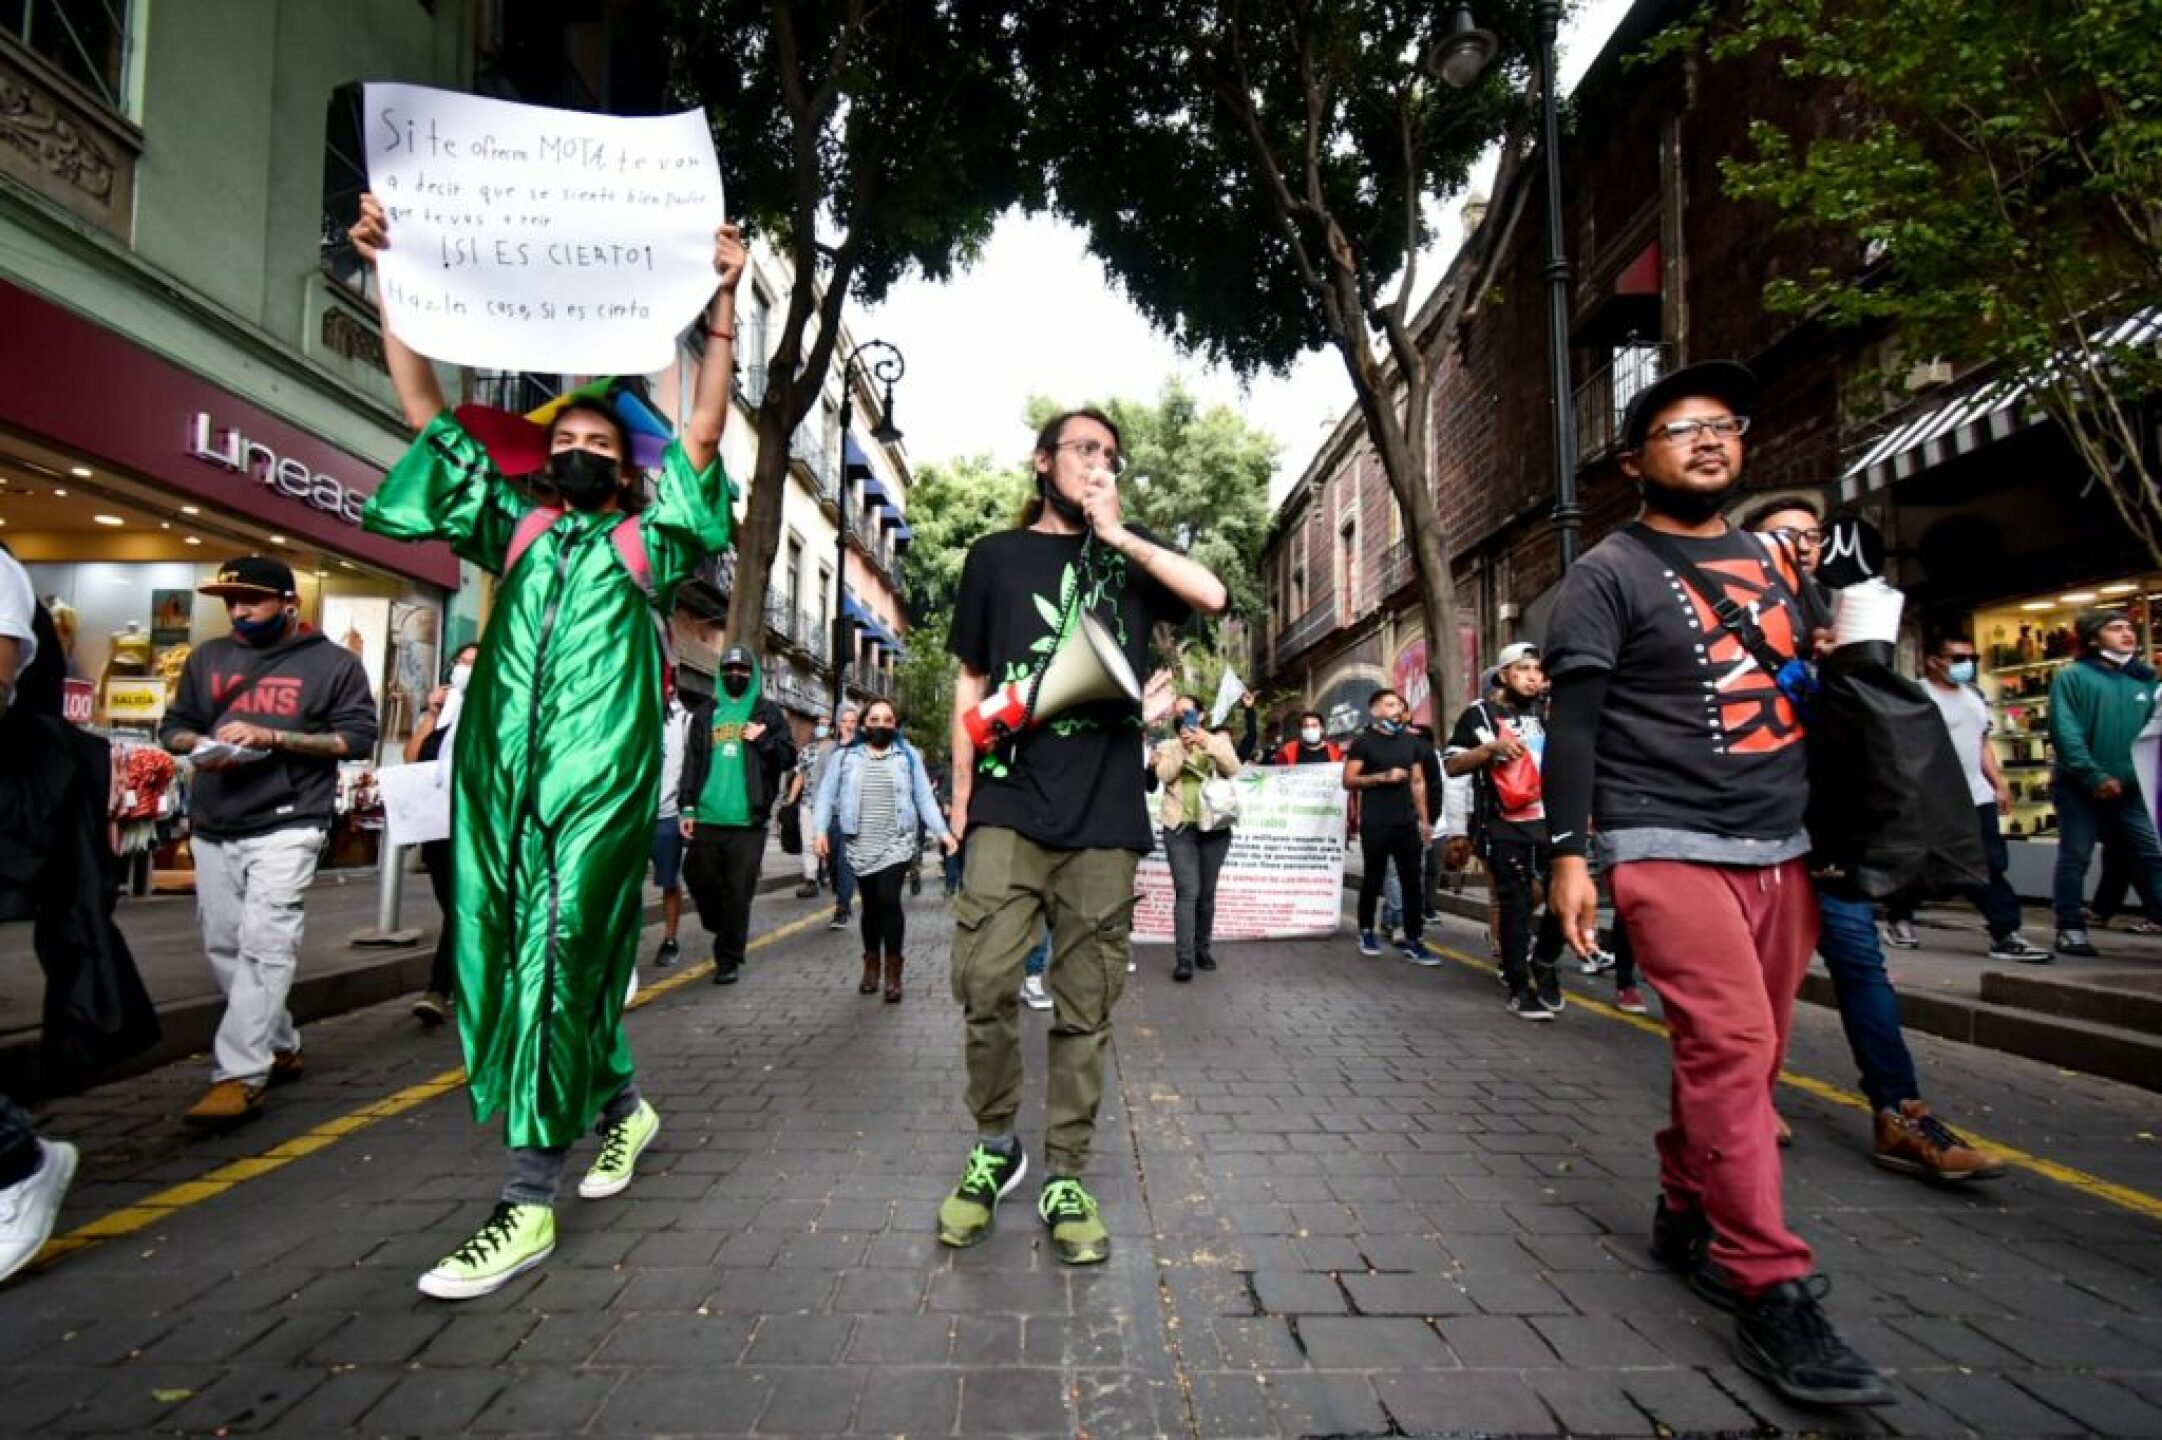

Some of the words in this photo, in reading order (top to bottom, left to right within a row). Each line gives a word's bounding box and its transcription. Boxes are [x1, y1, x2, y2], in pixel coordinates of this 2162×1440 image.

[381, 108, 414, 153] Si
[429, 118, 457, 158] te
[620, 146, 648, 173] te
[660, 156, 700, 170] van
[416, 169, 460, 196] decir
[480, 185, 515, 205] que
[390, 206, 413, 221] que
[495, 239, 529, 267] ES
[567, 303, 586, 321] es
[112, 695, 155, 705] SALIDA
[210, 672, 303, 717] VANS
